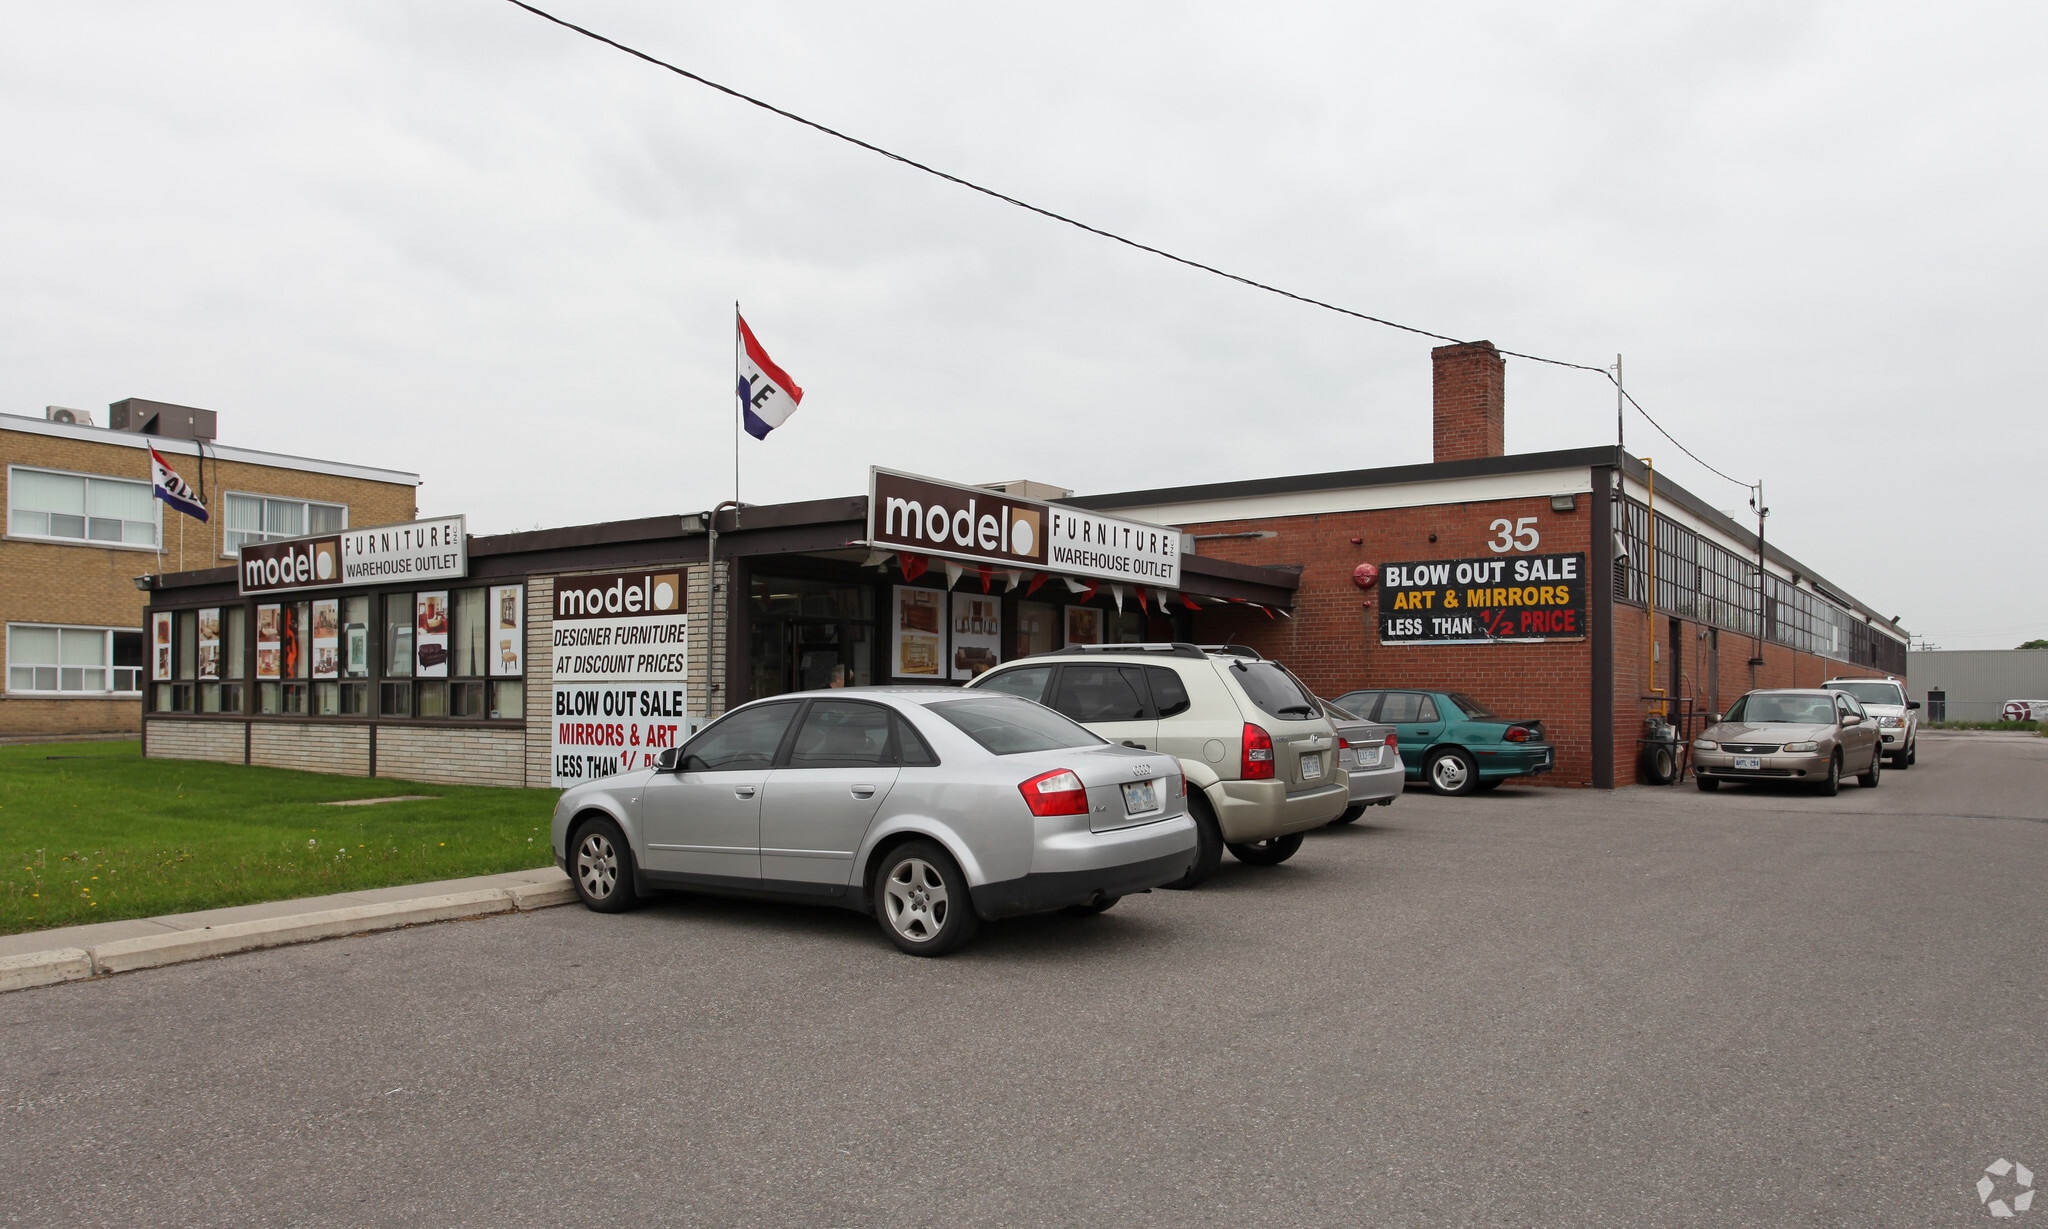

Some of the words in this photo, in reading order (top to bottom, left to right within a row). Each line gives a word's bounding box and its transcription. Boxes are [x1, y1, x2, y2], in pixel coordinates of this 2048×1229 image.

[345, 524, 451, 557] FURNITURE
[1053, 514, 1169, 556] FURNITURE
[1487, 516, 1540, 553] 35
[346, 559, 412, 579] WAREHOUSE
[415, 554, 458, 572] OUTLET
[1053, 546, 1130, 572] WAREHOUSE
[1133, 558, 1174, 579] OUTLET
[1386, 564, 1450, 587] BLOW
[1456, 562, 1505, 585] OUT
[1514, 558, 1577, 582] SALE
[1393, 590, 1436, 610] ART
[1443, 589, 1460, 609] &
[1467, 585, 1570, 608] MIRRORS
[554, 626, 612, 647] DESIGNER
[614, 623, 686, 645] FURNITURE
[1387, 618, 1423, 636] LESS
[1432, 617, 1473, 635] THAN
[1521, 609, 1576, 633] PRICE
[556, 655, 572, 674] AT
[573, 654, 634, 673] DISCOUNT
[637, 653, 684, 673] PRICES
[556, 690, 600, 716] BLOW
[603, 690, 637, 717] OUT
[640, 690, 683, 717] SALE
[559, 723, 624, 747] MIRRORS
[629, 723, 641, 747] &
[646, 724, 678, 747] ART
[556, 754, 583, 778] LESS
[587, 755, 618, 779] THAN
